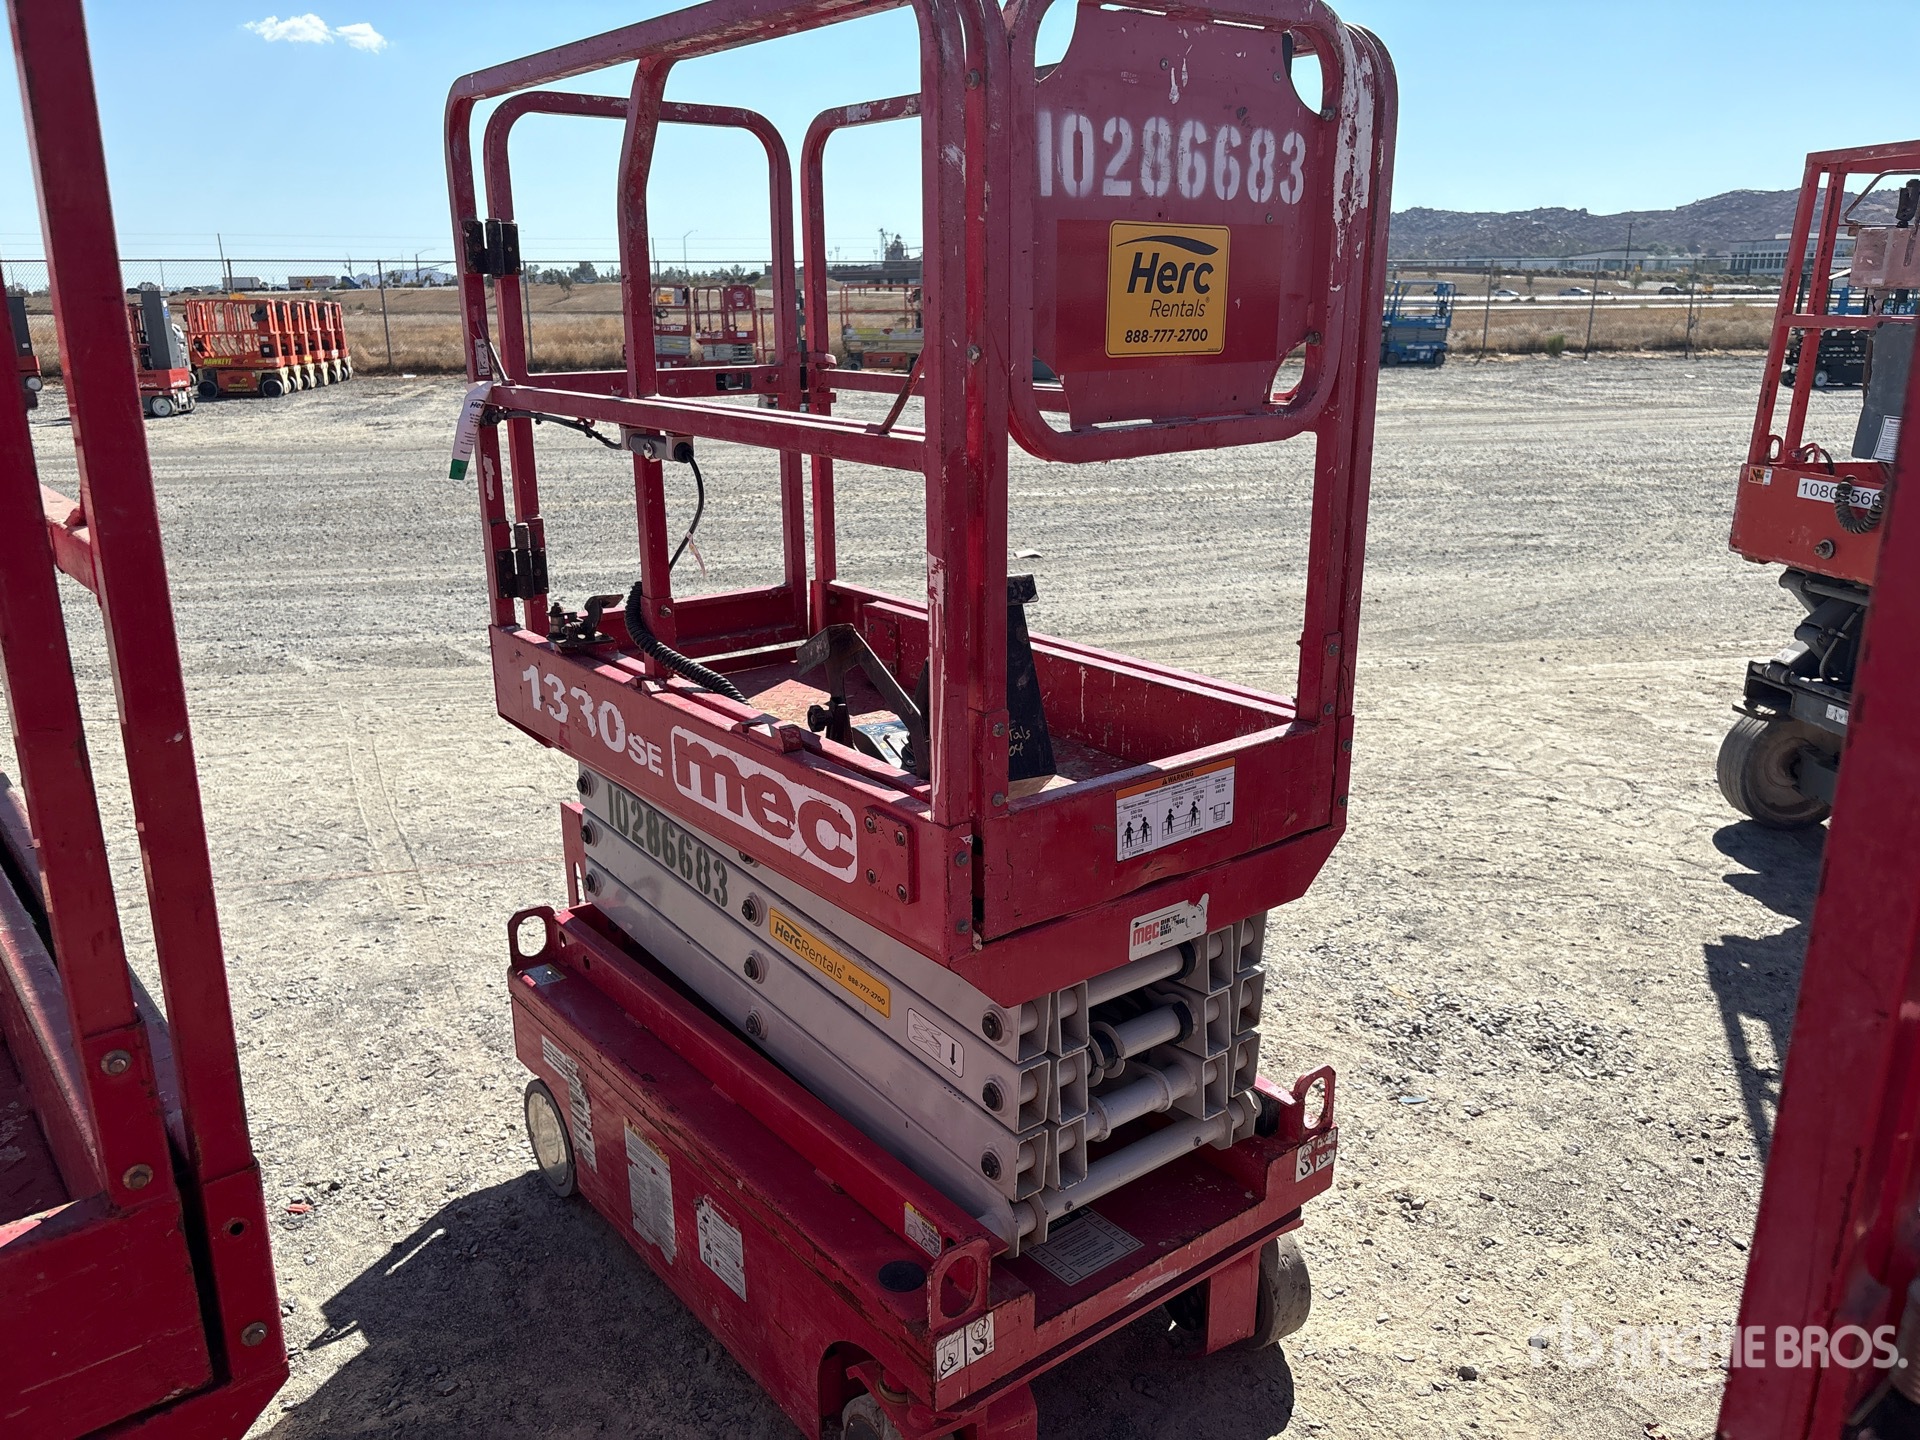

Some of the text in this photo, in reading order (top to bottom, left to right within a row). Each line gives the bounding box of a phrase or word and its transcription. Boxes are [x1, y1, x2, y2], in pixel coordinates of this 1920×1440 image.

[1037, 111, 1306, 205] 10286683
[1126, 252, 1214, 294] Herc
[1125, 328, 1208, 343] 888-777-2700
[1168, 771, 1194, 783] WARNING
[607, 783, 728, 908] 10286683
[1133, 921, 1160, 947] mec
